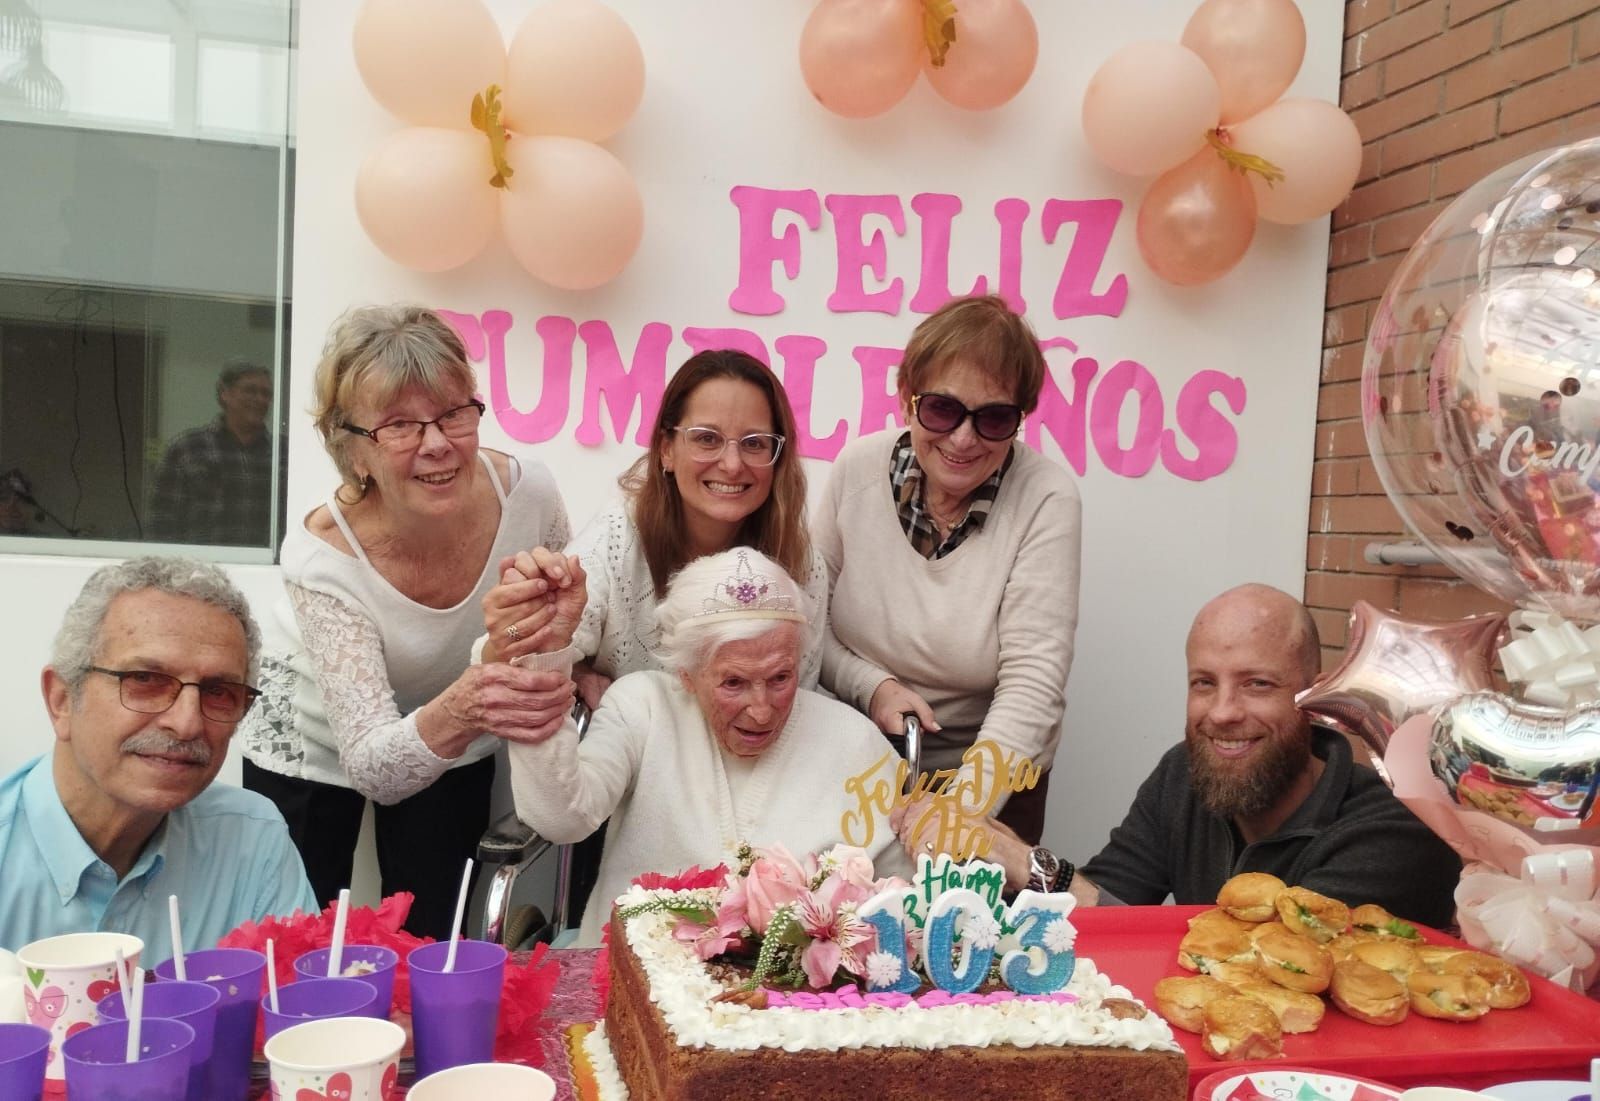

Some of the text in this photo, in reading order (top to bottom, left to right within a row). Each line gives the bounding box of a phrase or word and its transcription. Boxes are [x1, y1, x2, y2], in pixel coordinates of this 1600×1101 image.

[729, 185, 1130, 320] FELIZ
[841, 751, 960, 848] Feliz
[921, 860, 1004, 909] Happy
[857, 888, 1078, 996] 103
